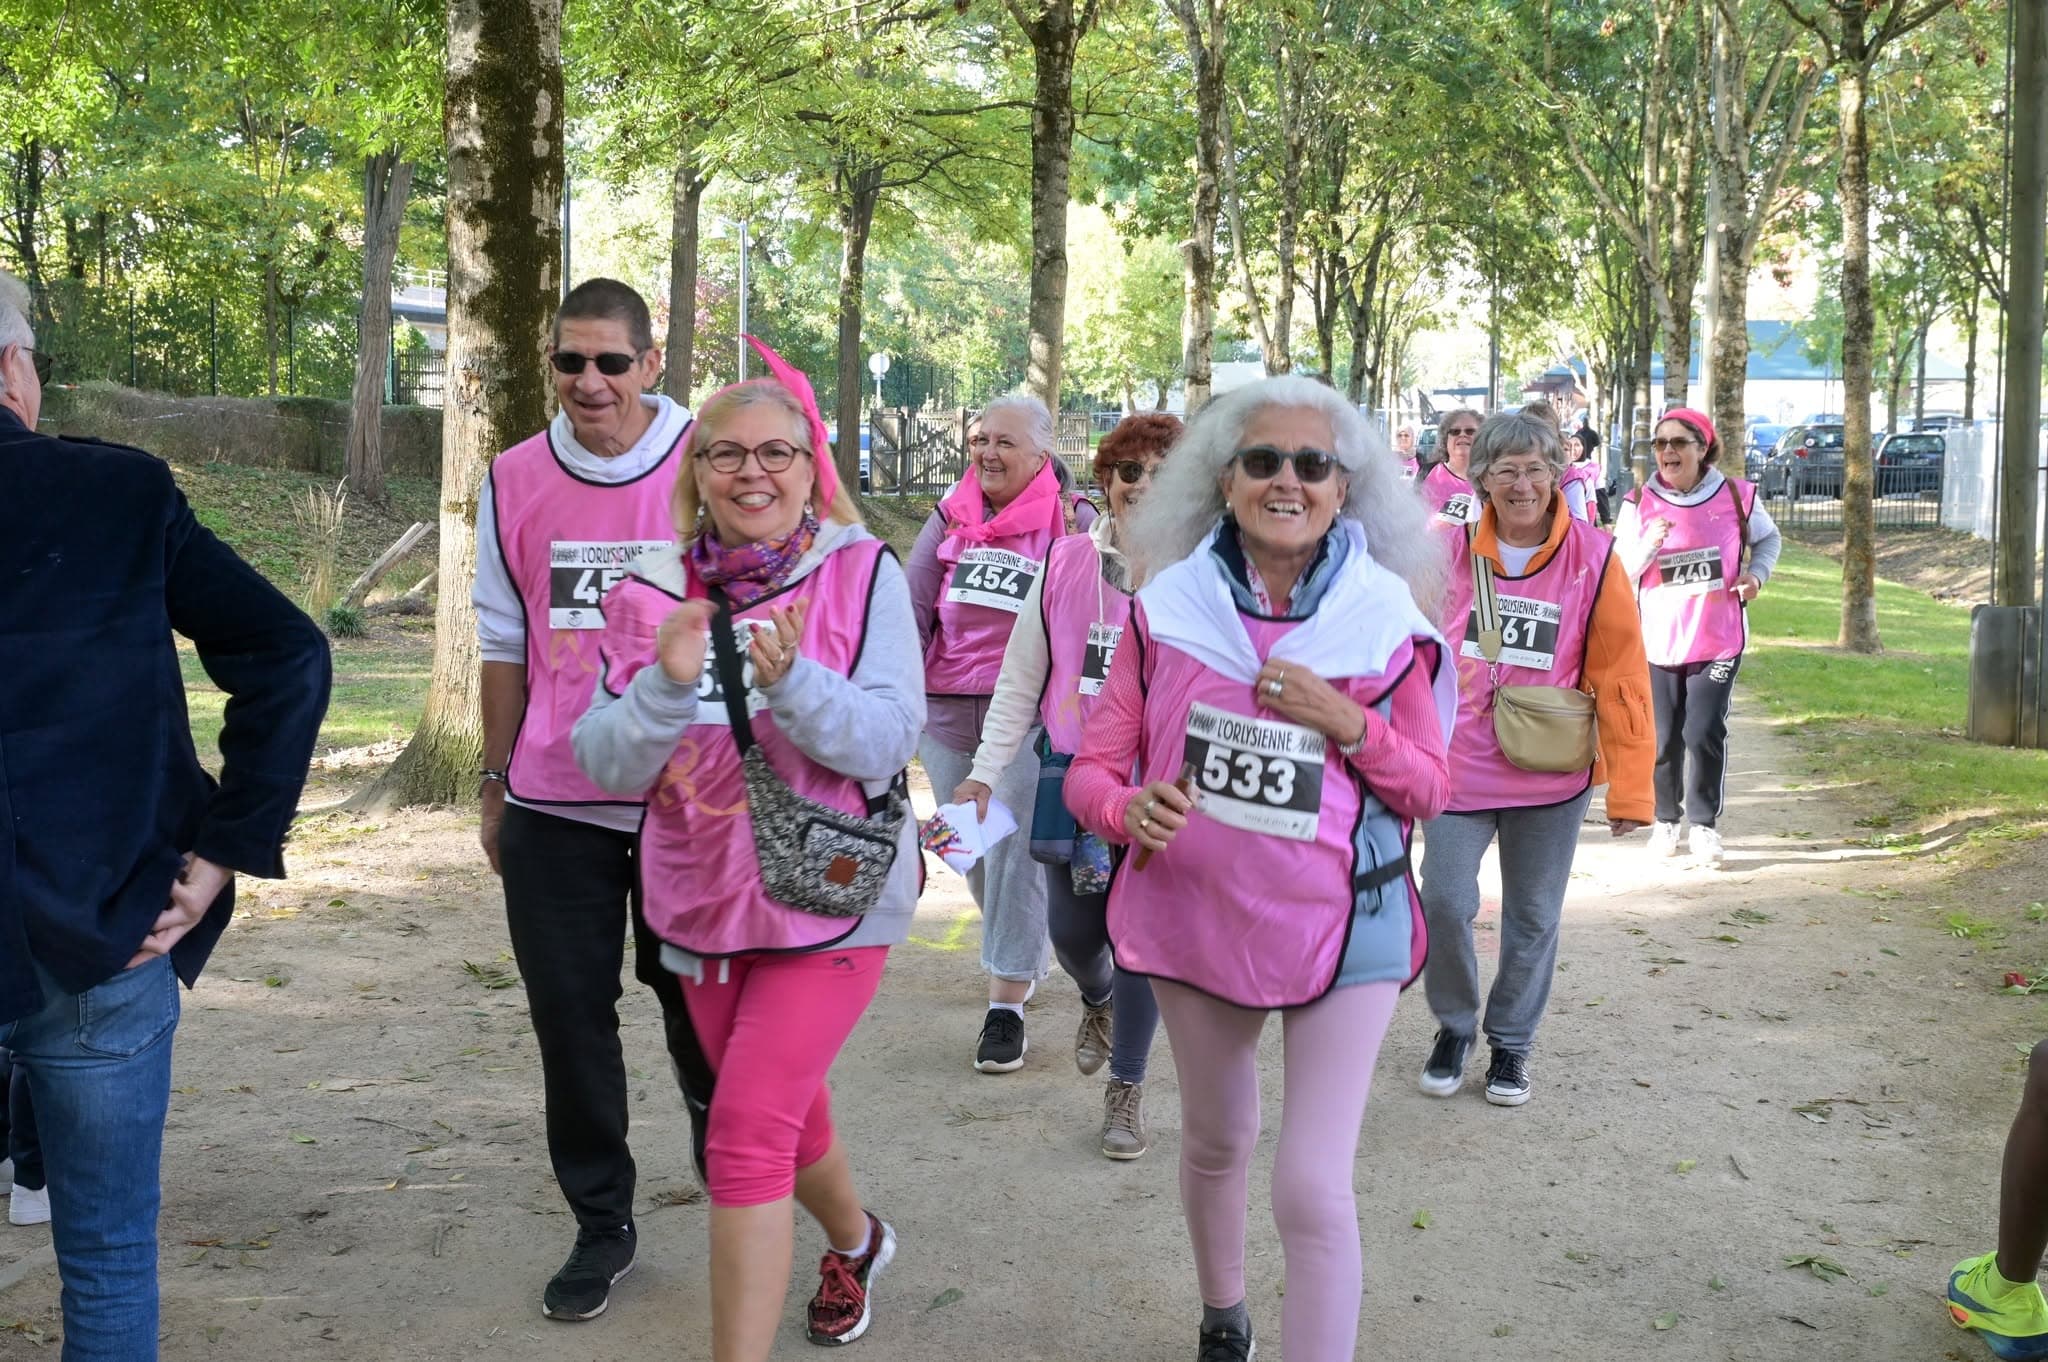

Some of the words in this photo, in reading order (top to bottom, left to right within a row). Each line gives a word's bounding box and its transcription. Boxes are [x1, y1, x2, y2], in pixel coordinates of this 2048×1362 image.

[977, 551, 1021, 568] L'ORLYSIENNE
[1672, 562, 1712, 585] 440
[965, 564, 1020, 595] 454
[1496, 597, 1540, 617] 'ORLYSIENNE
[1498, 616, 1538, 648] 61
[1217, 717, 1293, 753] L'ORLYSIENNE
[1202, 743, 1296, 805] 533
